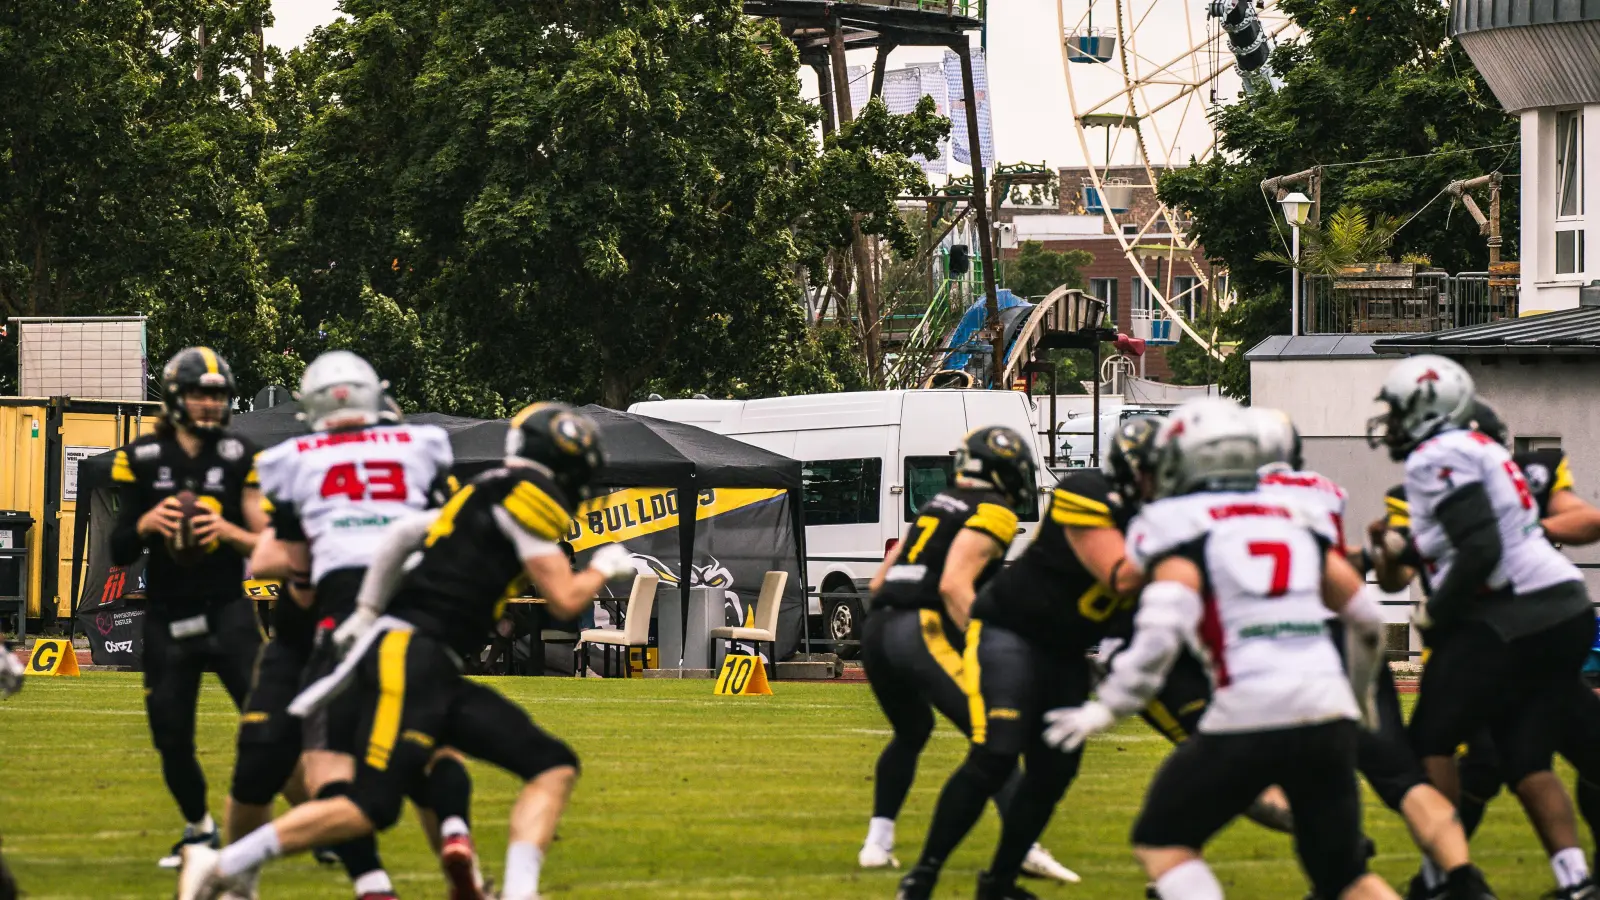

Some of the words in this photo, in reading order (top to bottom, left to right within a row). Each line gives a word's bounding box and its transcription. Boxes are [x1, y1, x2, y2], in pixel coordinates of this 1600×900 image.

[320, 460, 408, 501] 43
[586, 488, 717, 536] BULLDOS
[907, 515, 940, 564] 7
[101, 572, 126, 604] fit
[1247, 541, 1291, 597] 7
[32, 641, 59, 672] G
[721, 656, 753, 695] 10
